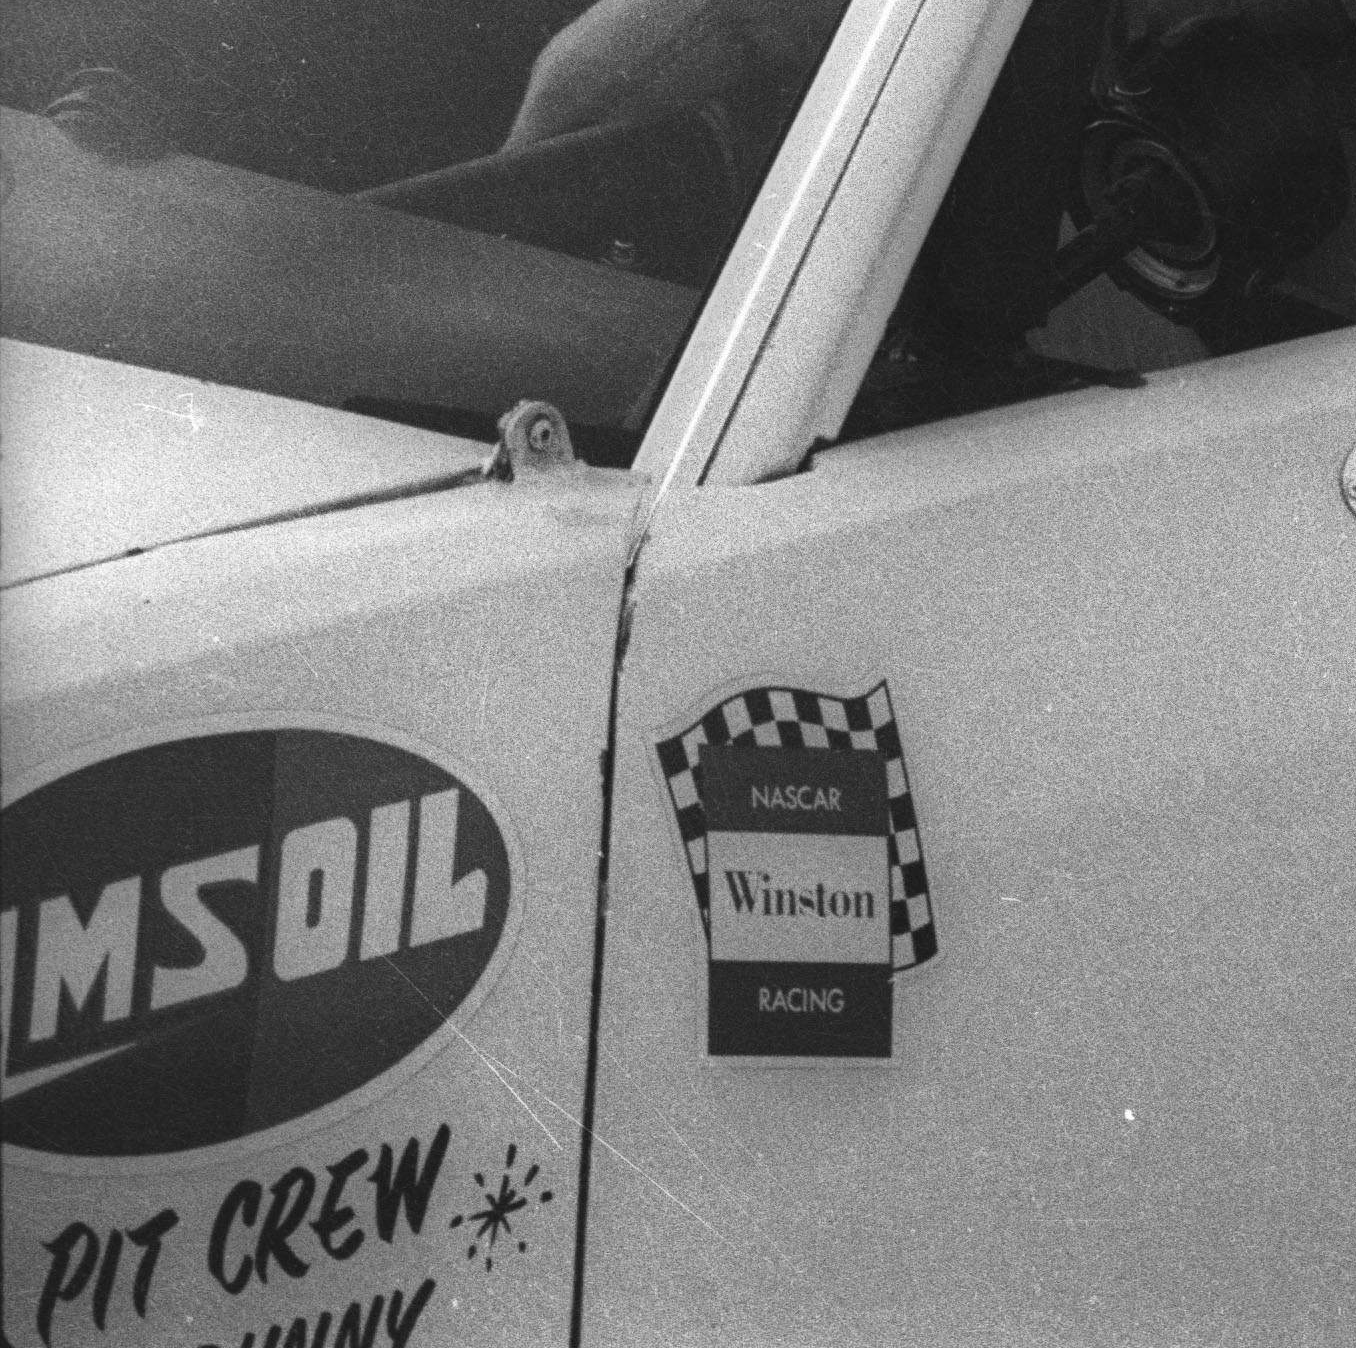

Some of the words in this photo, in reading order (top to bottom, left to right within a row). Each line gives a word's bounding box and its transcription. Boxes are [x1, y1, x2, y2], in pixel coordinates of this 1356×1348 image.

[750, 785, 843, 812] NASCAR
[723, 870, 876, 919] Winston
[757, 987, 846, 1013] RACING
[36, 1208, 179, 1348] PIT
[206, 1123, 452, 1295] CREW
